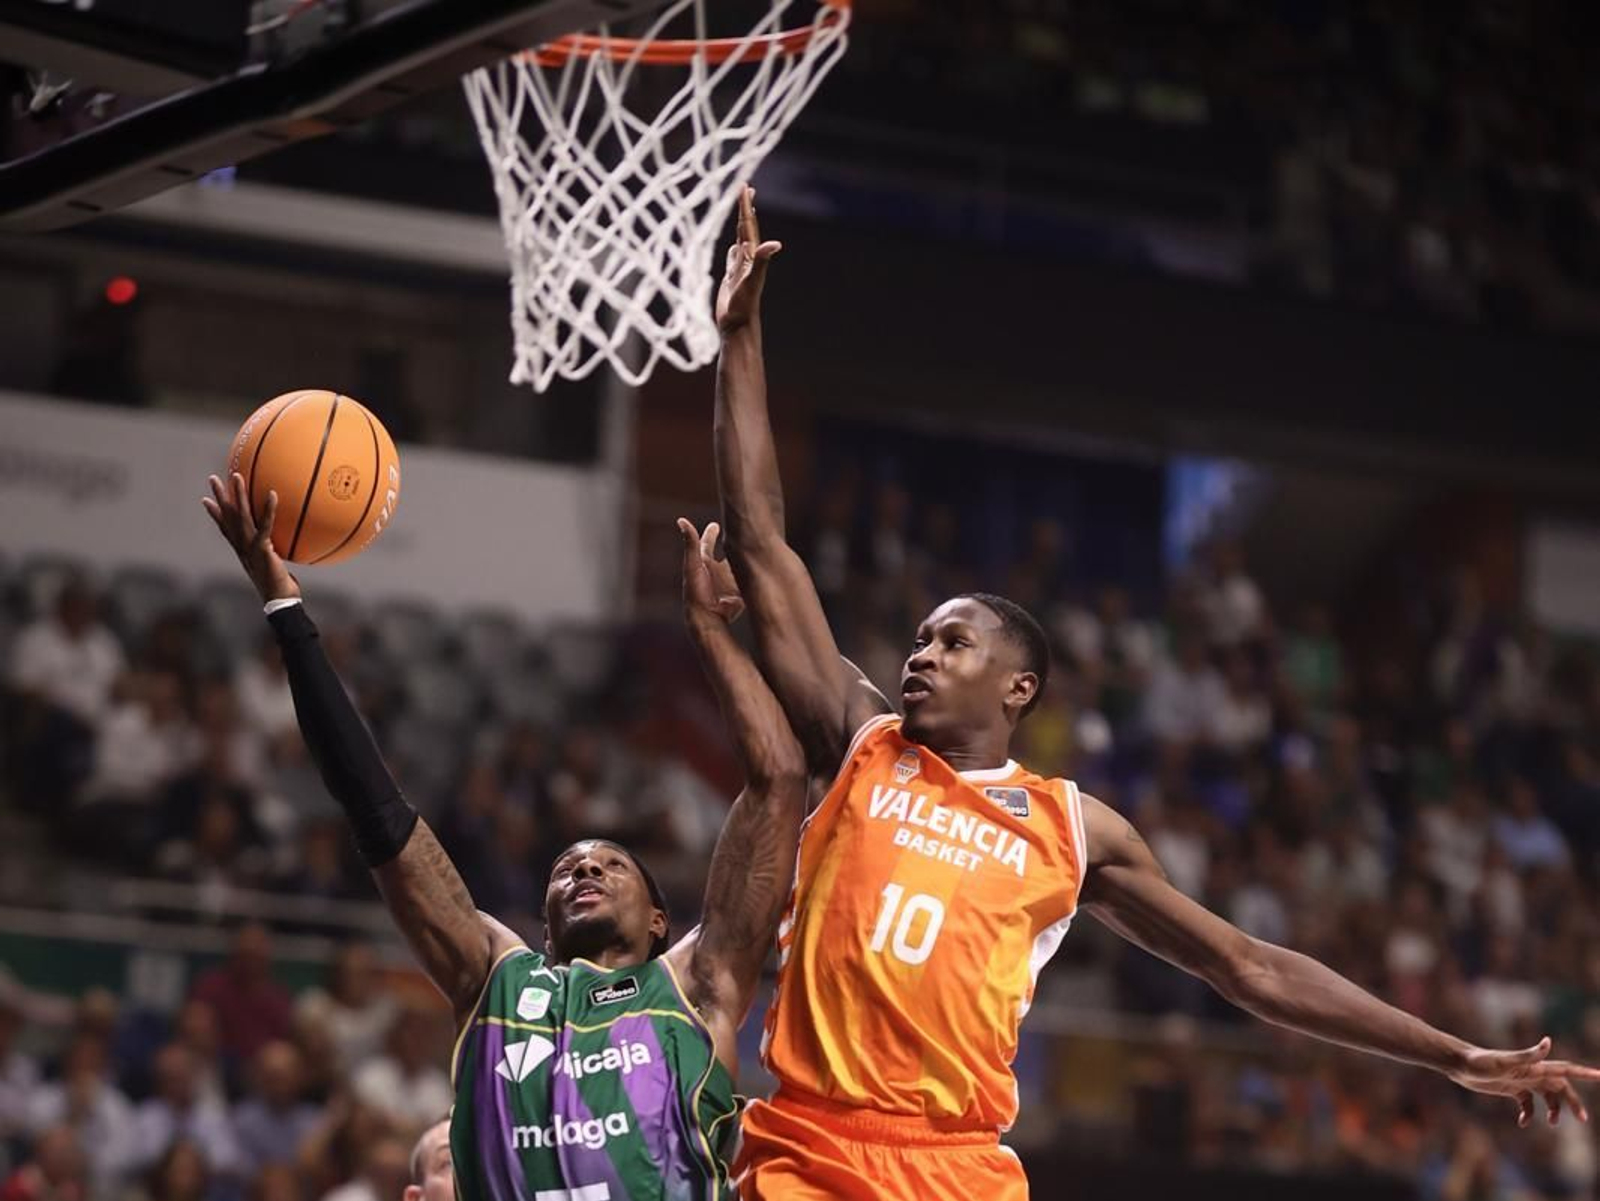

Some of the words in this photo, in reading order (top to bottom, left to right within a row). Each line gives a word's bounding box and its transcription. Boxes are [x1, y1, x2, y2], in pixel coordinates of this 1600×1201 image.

[867, 783, 1031, 877] VALENCIA
[894, 827, 984, 873] BASKET
[869, 882, 946, 966] 10
